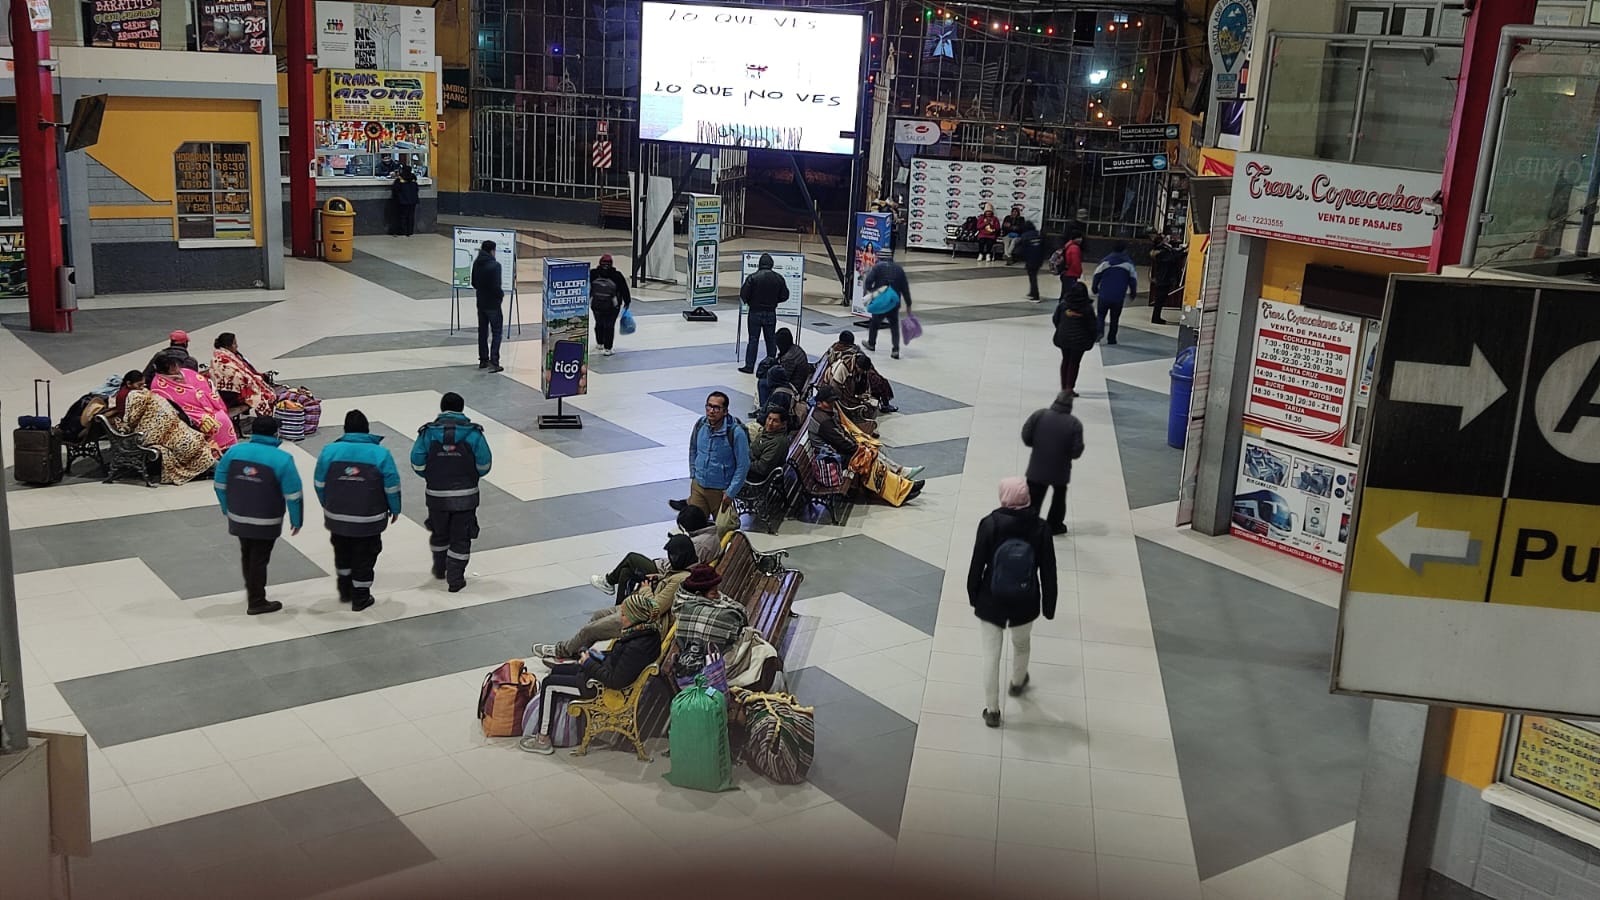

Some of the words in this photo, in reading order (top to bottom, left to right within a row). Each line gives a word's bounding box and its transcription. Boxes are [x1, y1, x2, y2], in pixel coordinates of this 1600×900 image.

[205, 3, 252, 14] CAPPUCCINO
[245, 18, 266, 33] 2x1
[334, 72, 380, 87] TRANS.
[334, 88, 424, 100] AROMA
[654, 81, 681, 93] LO
[693, 84, 733, 97] QUE
[748, 90, 783, 99] NO
[796, 93, 841, 106] VES
[175, 153, 209, 161] HORARIOS
[224, 153, 247, 161] SALIDA
[184, 172, 209, 180] 11:00
[1246, 161, 1309, 201] Trans.
[1252, 216, 1284, 227] 72233555
[1318, 212, 1346, 224] VENTA
[1349, 216, 1360, 226] DE
[1363, 218, 1403, 232] PASAJES
[552, 280, 586, 289] VELOCIDAD
[556, 288, 581, 297] CALIDAD
[551, 296, 587, 306] COBERTURA
[1287, 309, 1338, 330] Copacabana
[1270, 323, 1294, 333] VENTA
[1296, 327, 1306, 336] DE
[1309, 330, 1342, 342] PASAJES
[1283, 335, 1325, 348] COCHABAMBA
[1283, 343, 1299, 352] 10:00
[1261, 352, 1278, 361] 22:00
[1282, 357, 1299, 366] 22:30
[1316, 357, 1333, 366] 21:30
[1281, 365, 1301, 375] SANTA
[1302, 370, 1319, 379] CRUZ
[1256, 369, 1273, 378] 14:00
[1302, 379, 1319, 389] 17:30
[1325, 385, 1343, 395] 19:00
[1265, 380, 1286, 390] SUCRE
[1284, 404, 1305, 414] TARIJA
[1322, 403, 1340, 413] 21:00
[1511, 528, 1600, 583] Pu
[1532, 722, 1571, 742] SALIDAS
